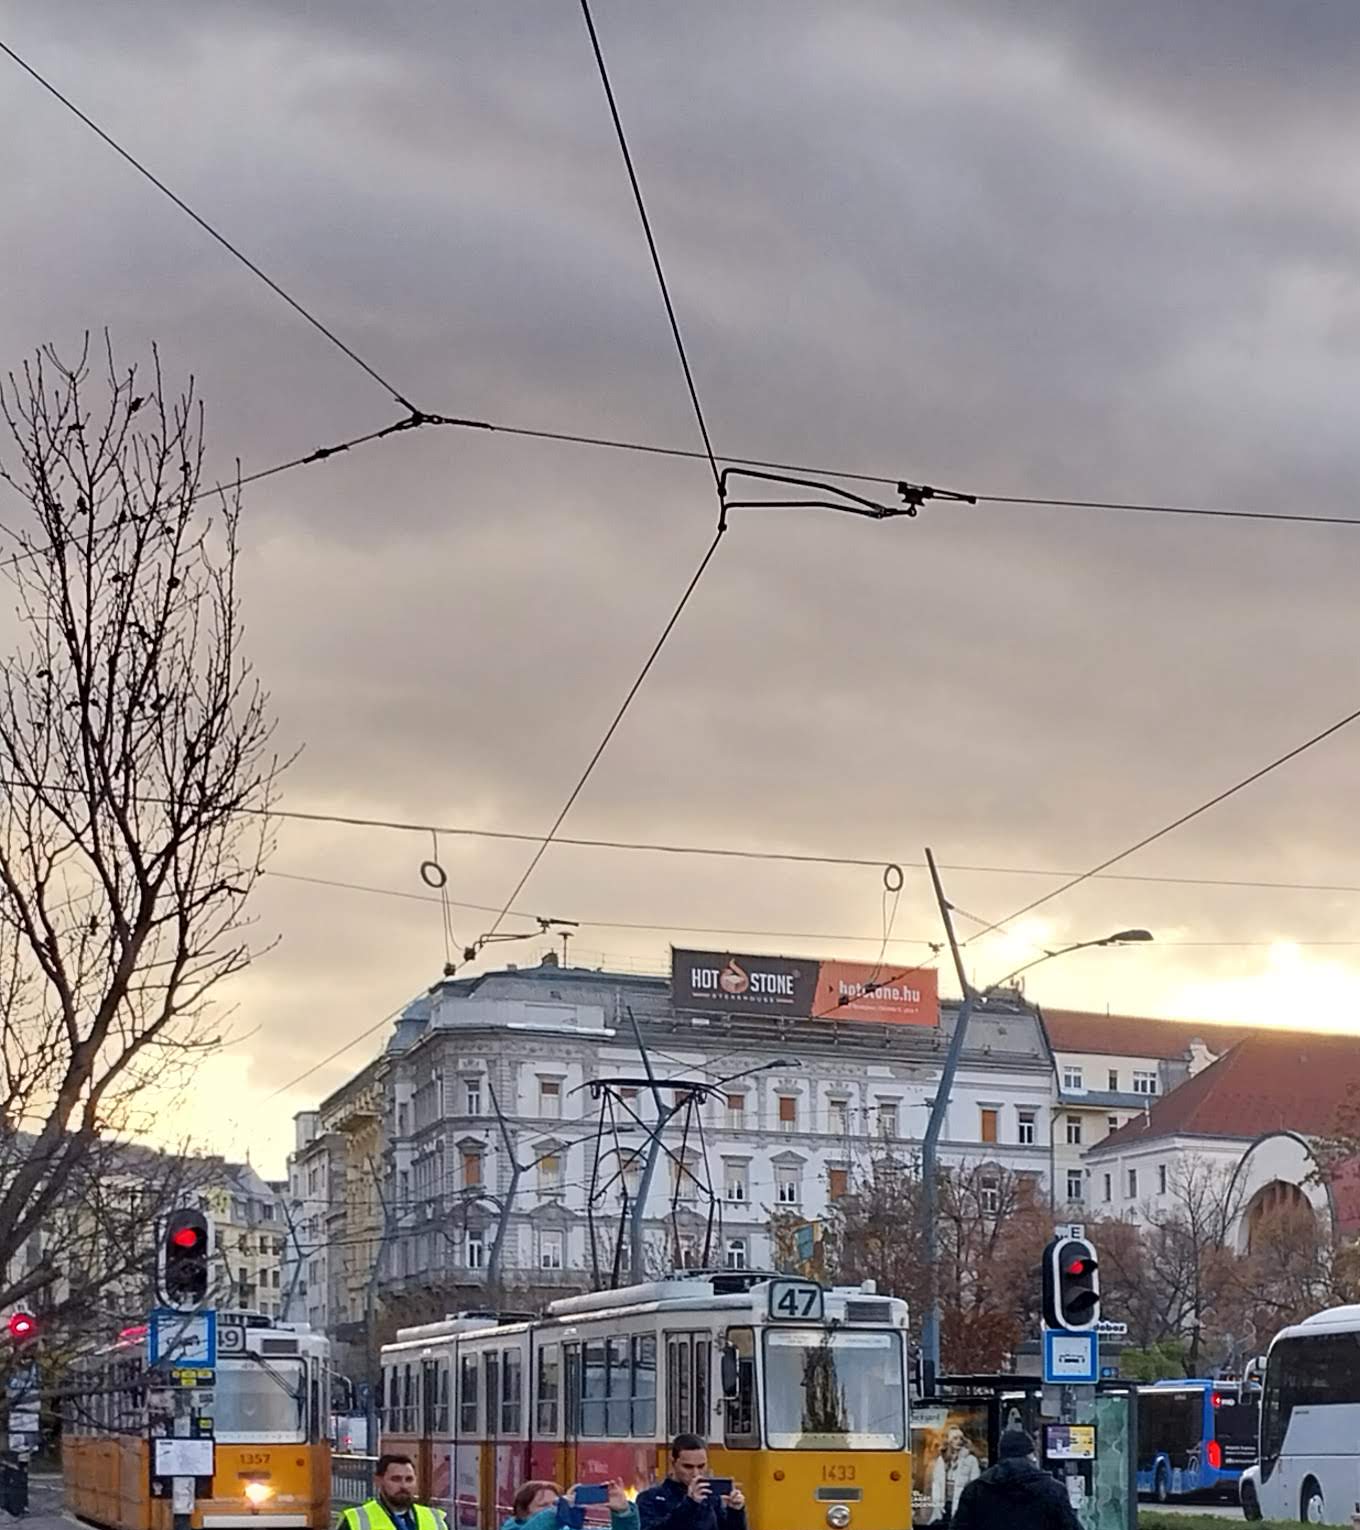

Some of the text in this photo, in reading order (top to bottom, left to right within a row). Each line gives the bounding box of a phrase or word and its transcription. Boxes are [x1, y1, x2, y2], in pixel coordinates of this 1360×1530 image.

[691, 967, 795, 995] HOT STONE
[1070, 1226, 1081, 1239] E
[777, 1288, 818, 1316] 47
[239, 1453, 271, 1465] 1357
[821, 1464, 856, 1481] 1433
